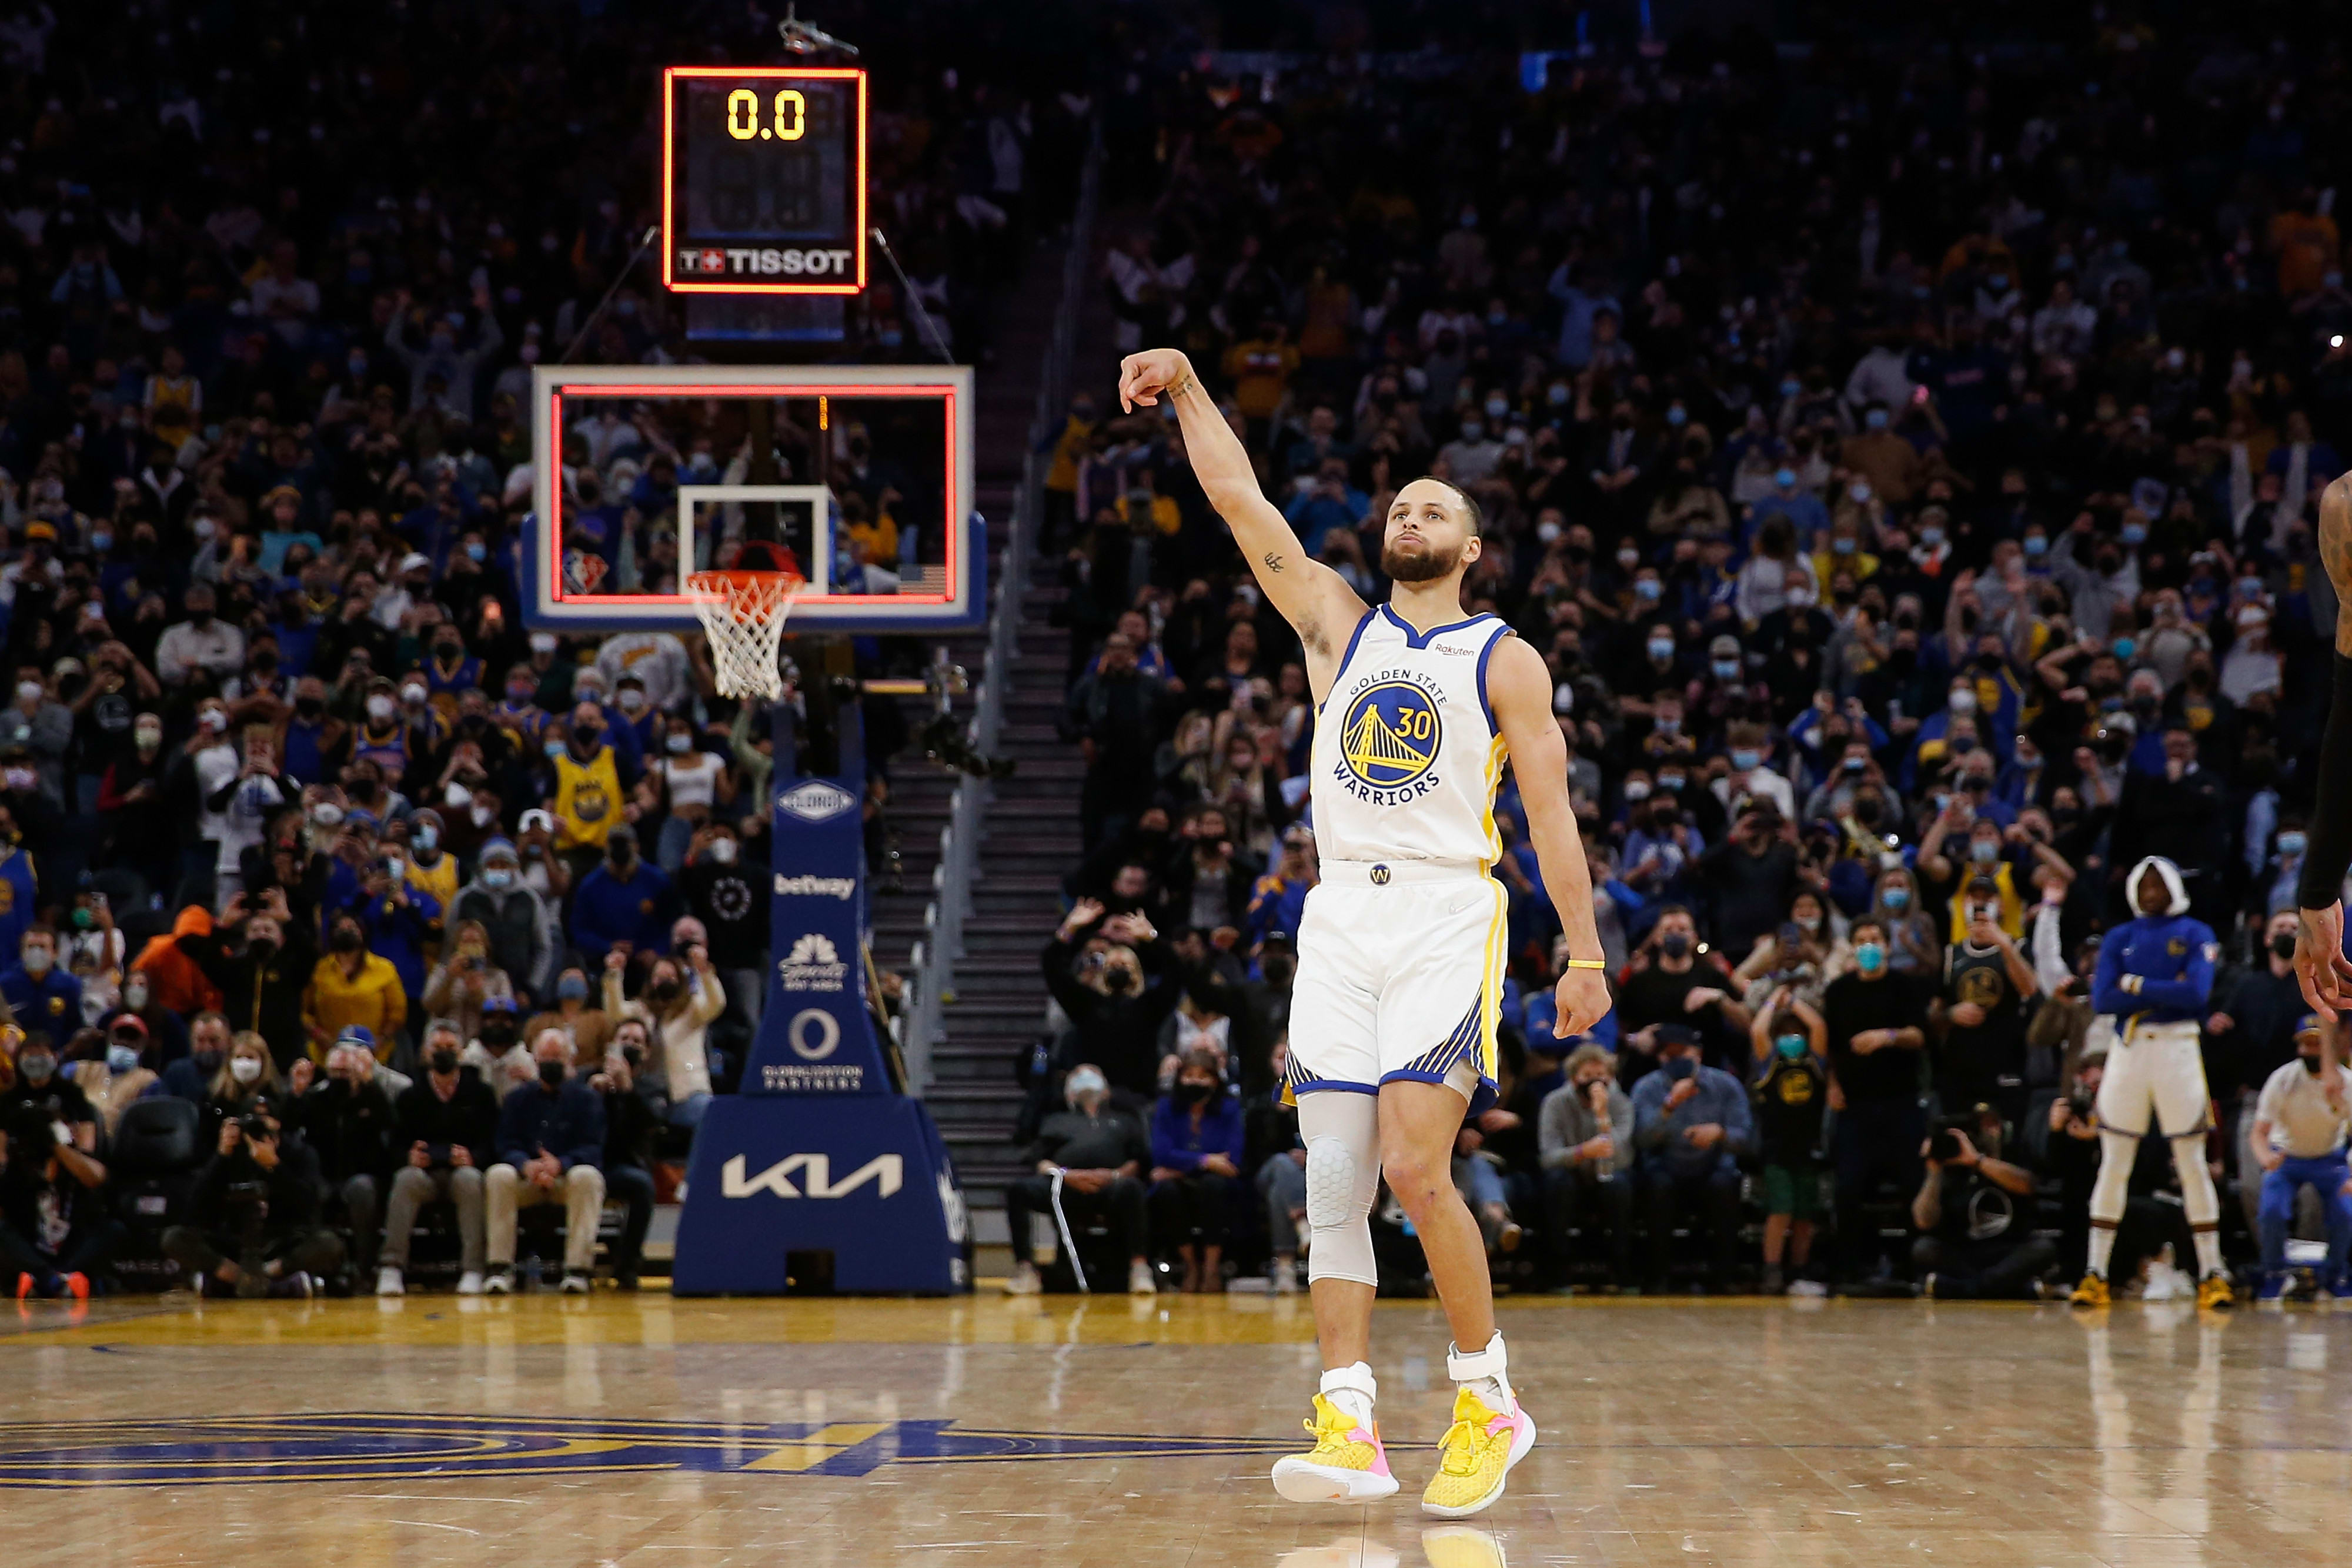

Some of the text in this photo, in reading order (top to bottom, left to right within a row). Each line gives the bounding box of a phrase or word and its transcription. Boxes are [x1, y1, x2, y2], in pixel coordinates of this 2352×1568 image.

[728, 89, 805, 141] 0.0
[726, 249, 852, 274] TISSOT
[1435, 643, 1474, 657] Rakuten
[1350, 669, 1448, 706] GOLDEN STATE
[1394, 707, 1432, 740] 30
[1333, 760, 1440, 806] WARRIORS
